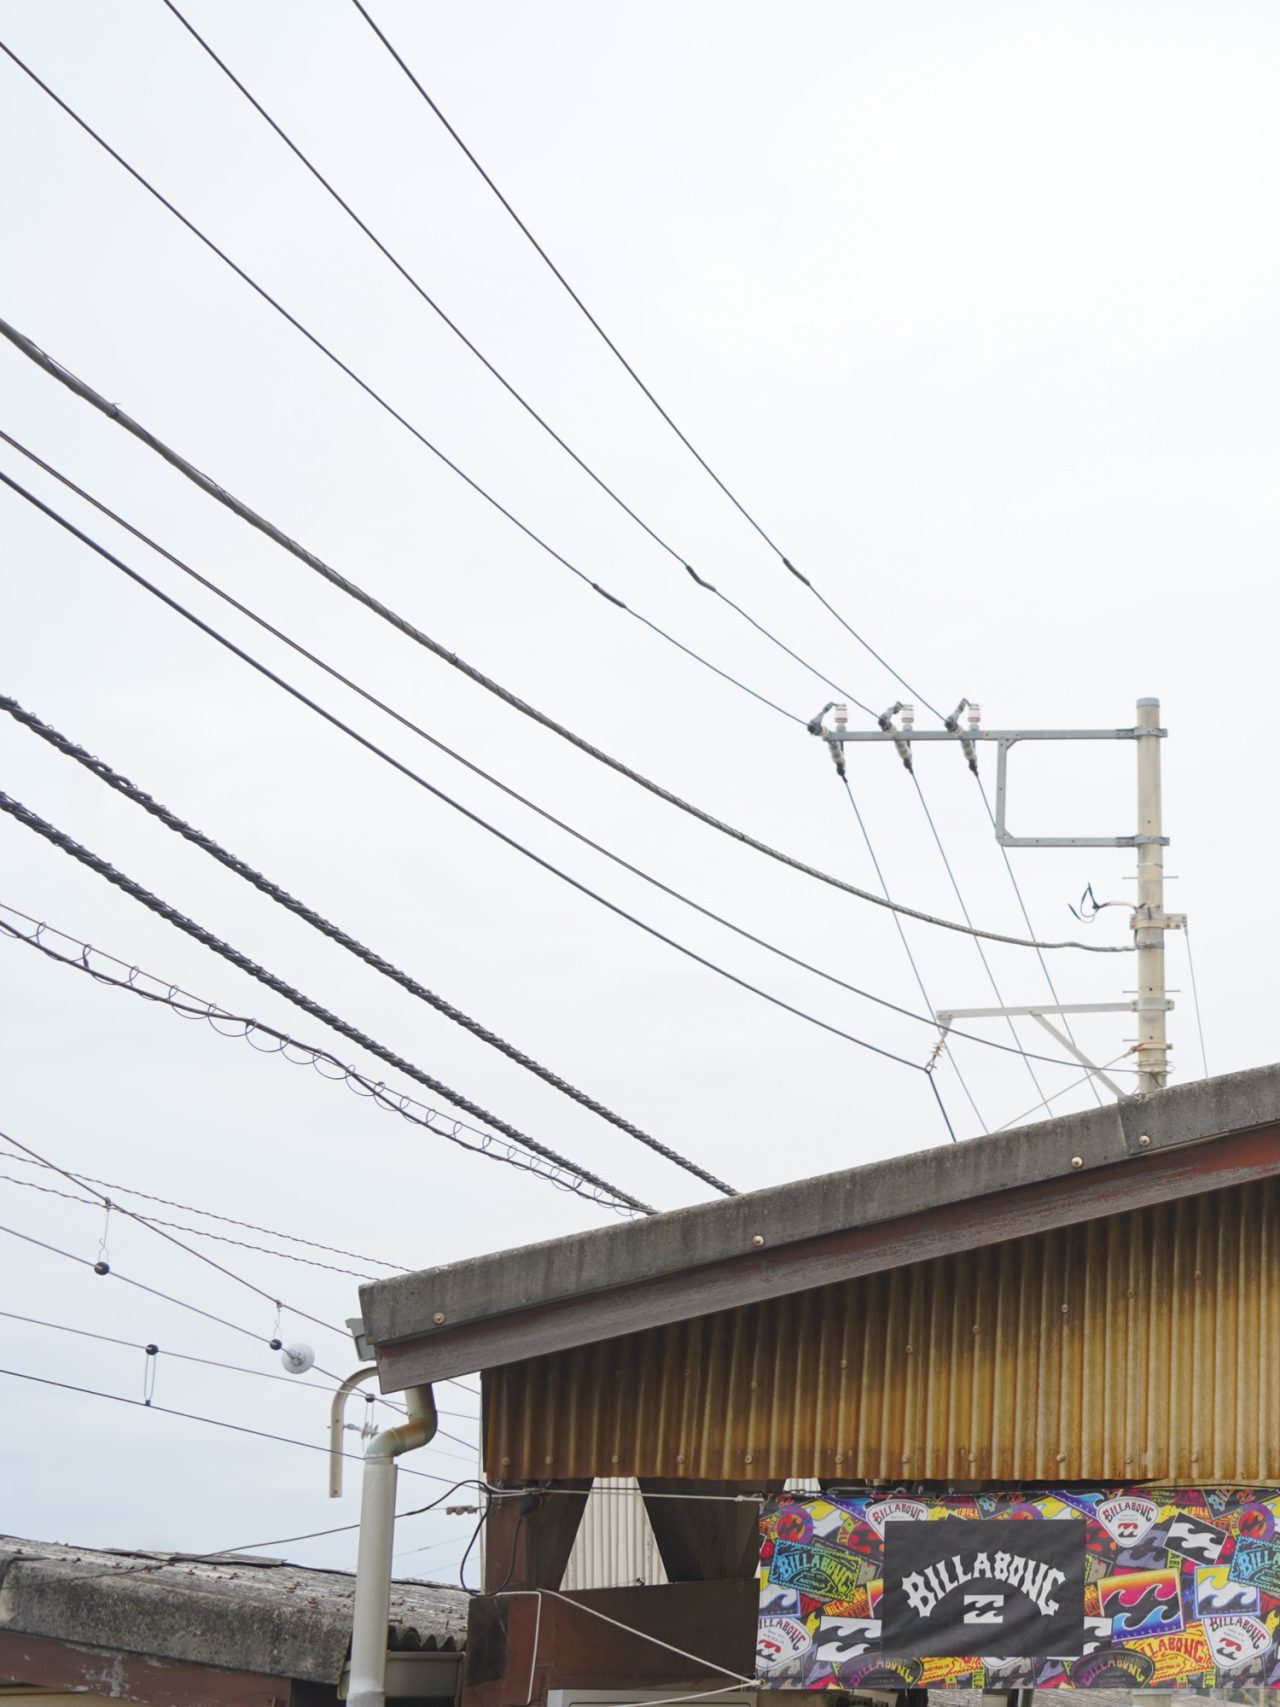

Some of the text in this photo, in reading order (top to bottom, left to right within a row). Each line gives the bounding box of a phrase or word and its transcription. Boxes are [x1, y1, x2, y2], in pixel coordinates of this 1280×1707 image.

[1102, 1500, 1155, 1523] BILLABONG
[779, 1552, 855, 1597] BILLABONG
[902, 1550, 1066, 1618] BILLABONG
[758, 1617, 807, 1651] ILLABONG
[1209, 1616, 1267, 1650] BILLABONG
